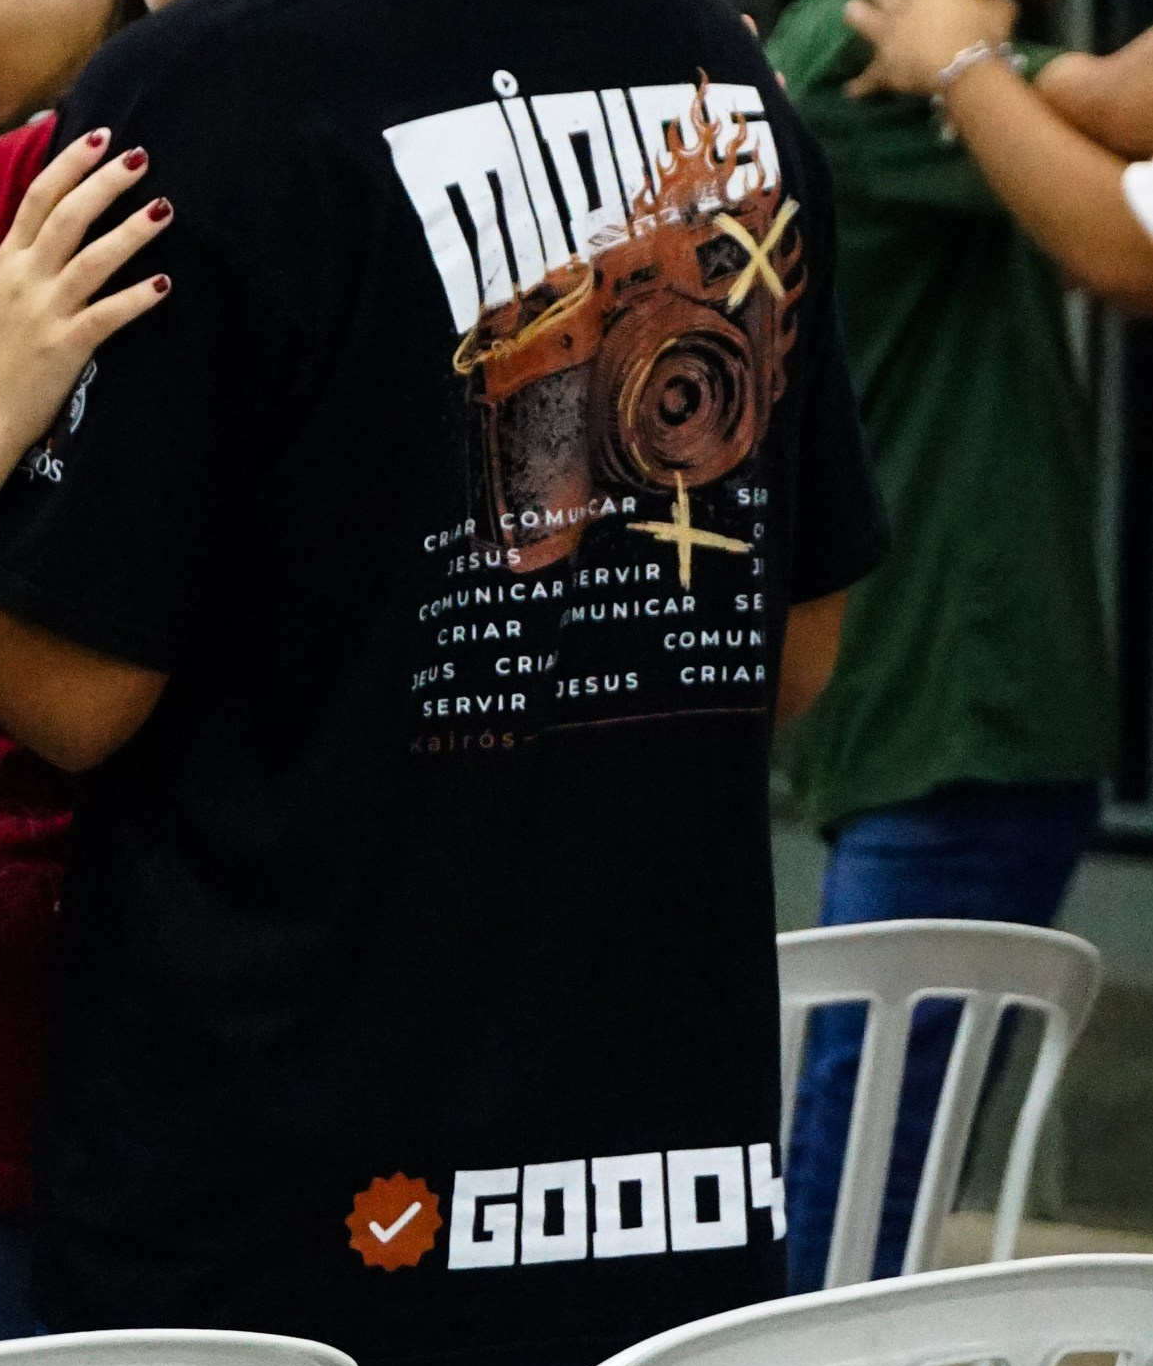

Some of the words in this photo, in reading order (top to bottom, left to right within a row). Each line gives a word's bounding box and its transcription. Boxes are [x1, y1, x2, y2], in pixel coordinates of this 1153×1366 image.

[448, 548, 522, 576] JESUS
[419, 580, 564, 621] COMUNICAR
[572, 563, 661, 588] ERVIR
[438, 620, 522, 646] CRIAR
[423, 692, 527, 717] SERVIR
[556, 671, 639, 699] JESUS
[680, 665, 766, 684] CRIAR
